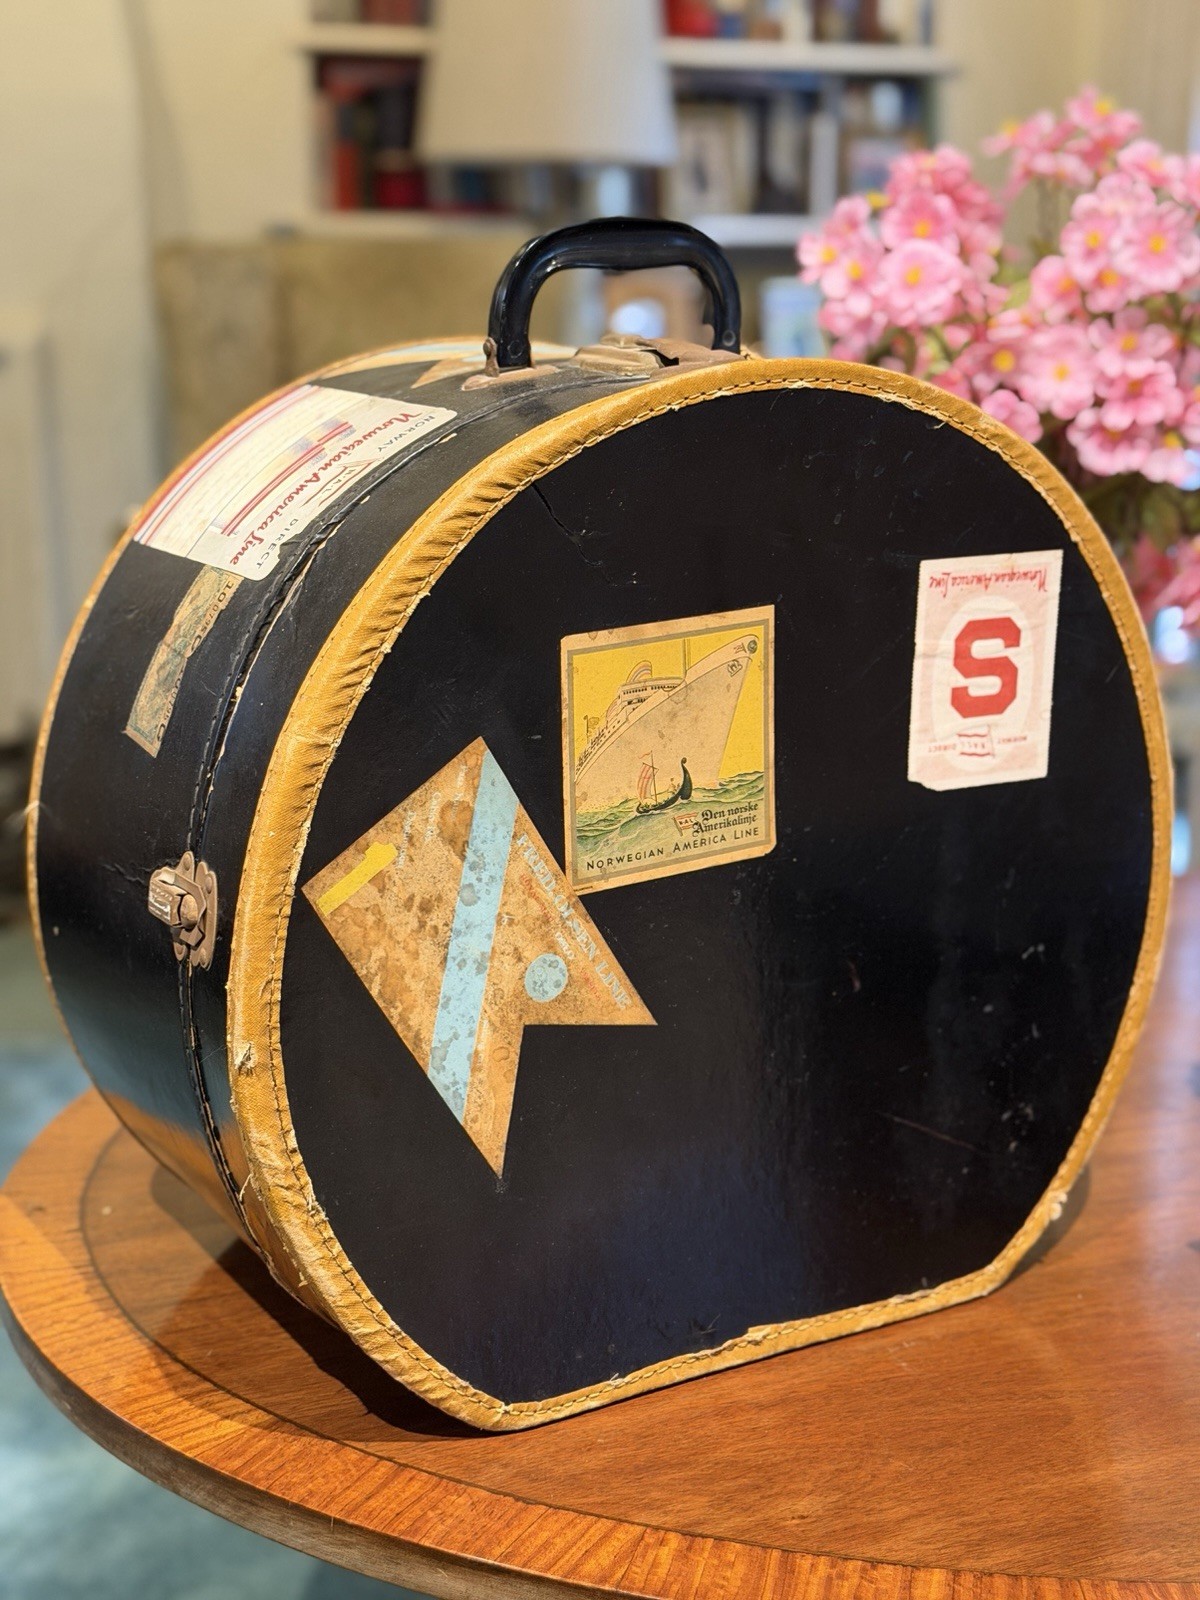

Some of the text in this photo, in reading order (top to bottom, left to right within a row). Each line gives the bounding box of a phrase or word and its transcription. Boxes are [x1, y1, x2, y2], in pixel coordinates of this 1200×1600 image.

[378, 415, 436, 452] NORWAY
[230, 412, 422, 565] Norwegian America Line
[255, 518, 299, 569] DIRECT
[929, 567, 1048, 598] Norwegian America Line
[951, 616, 1021, 718] S
[692, 813, 758, 838] Amerikalinje
[701, 801, 759, 823] Den norske
[586, 827, 759, 871] NORWEGIAN AMERICA LINE
[596, 960, 632, 1010] LINE
